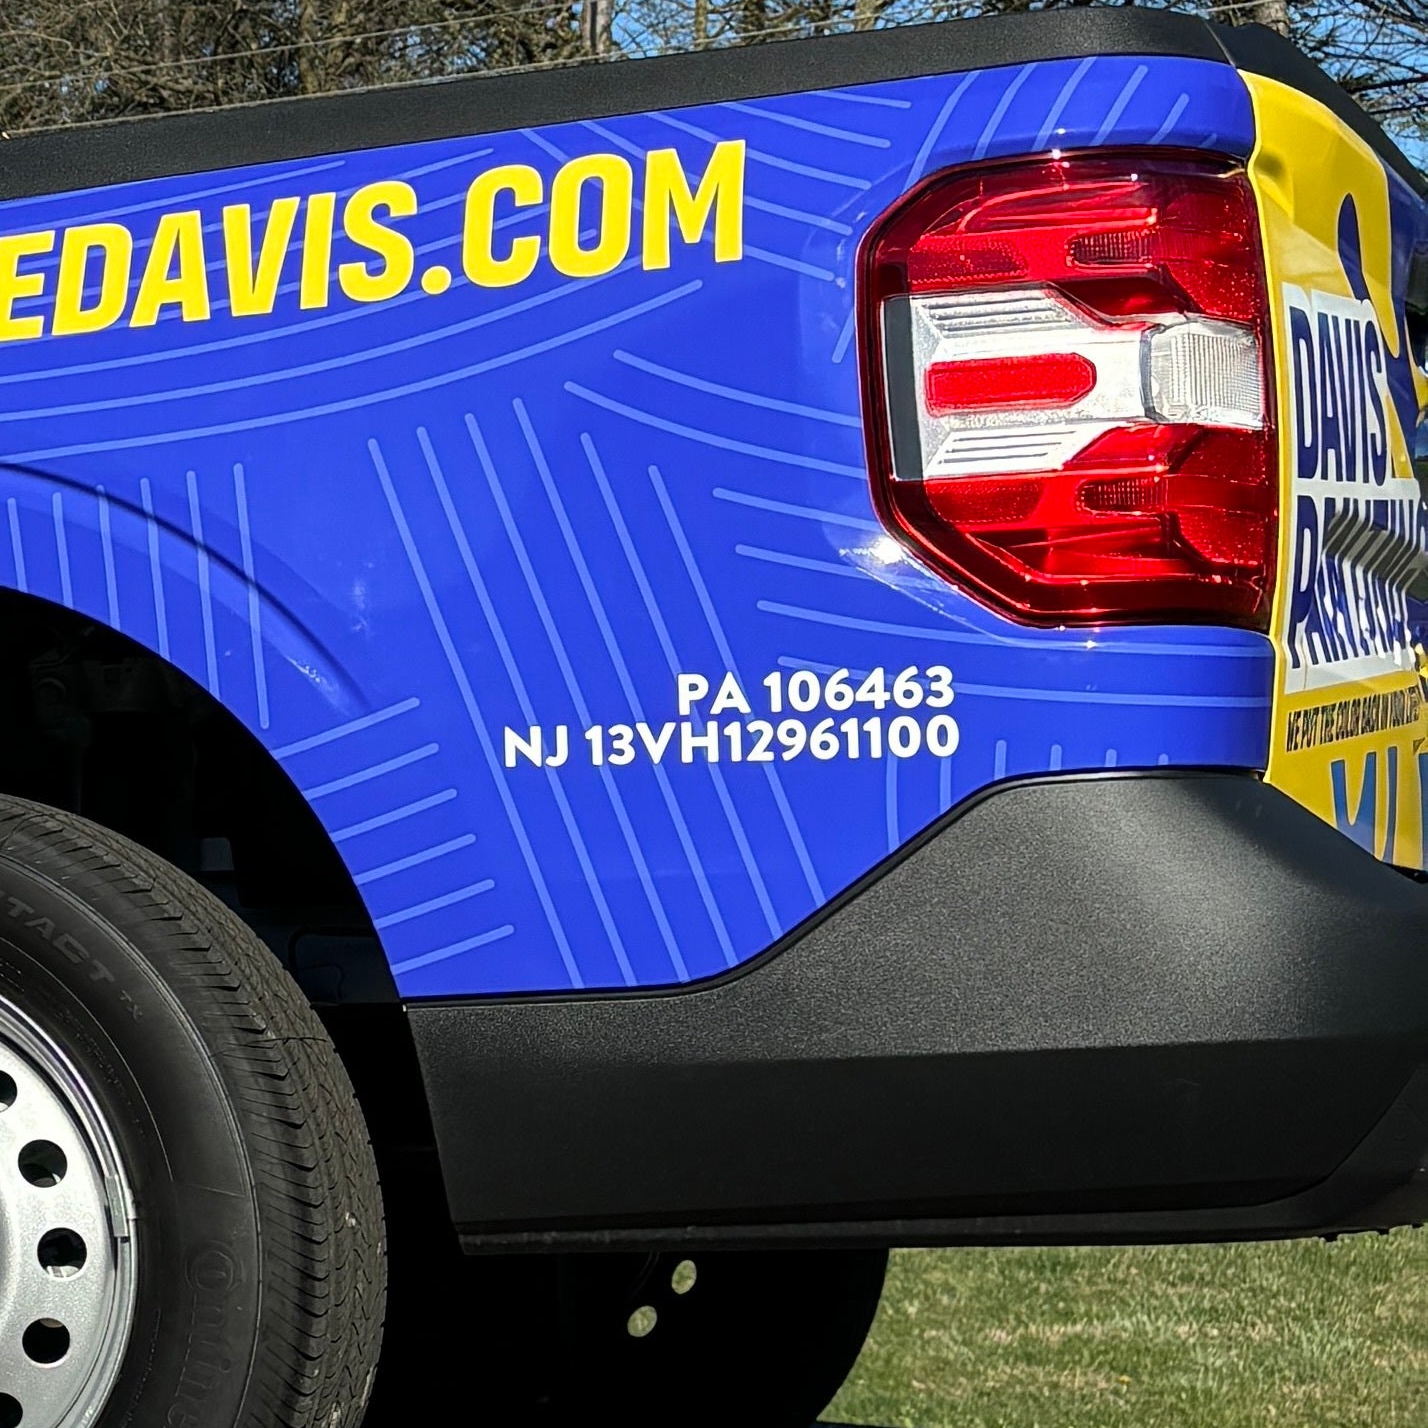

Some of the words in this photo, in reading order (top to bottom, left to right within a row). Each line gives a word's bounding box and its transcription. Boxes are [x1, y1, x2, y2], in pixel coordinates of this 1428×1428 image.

[1289, 306, 1387, 486] DAVIS
[677, 672, 752, 716] PA
[763, 665, 955, 714] 106463
[503, 725, 569, 768] NJ
[585, 714, 961, 766] 13VH12961100
